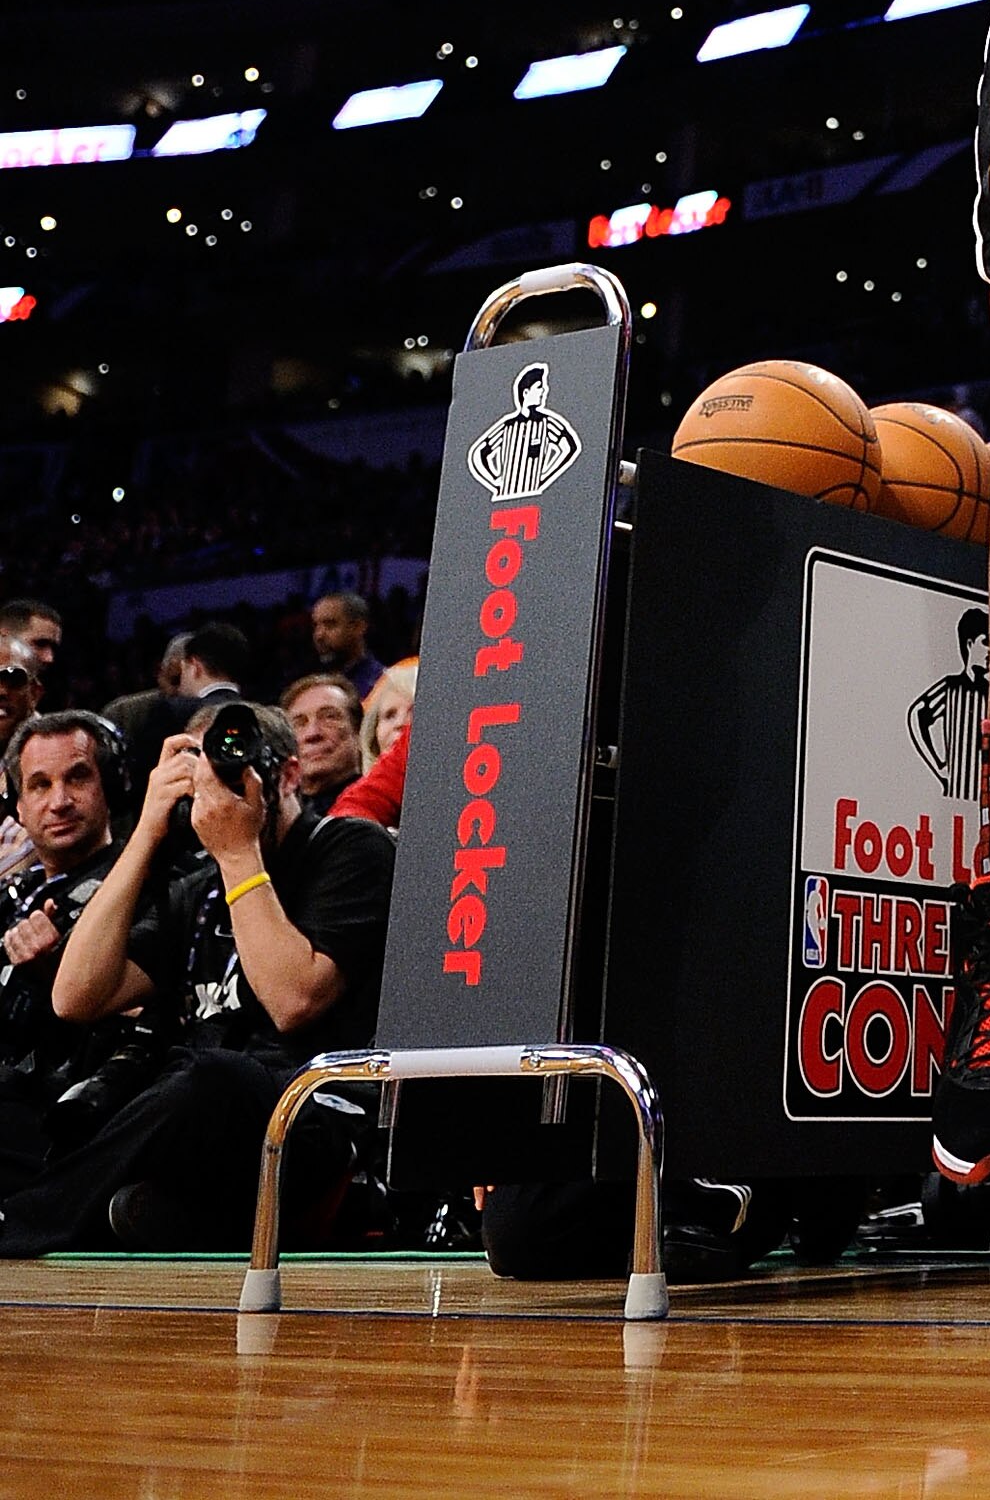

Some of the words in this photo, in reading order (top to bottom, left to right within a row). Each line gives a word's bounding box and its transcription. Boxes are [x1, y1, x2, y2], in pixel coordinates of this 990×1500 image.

[474, 505, 542, 677] Foot
[443, 703, 522, 986] Locker
[833, 798, 936, 882] Foot
[831, 889, 956, 980] THRE
